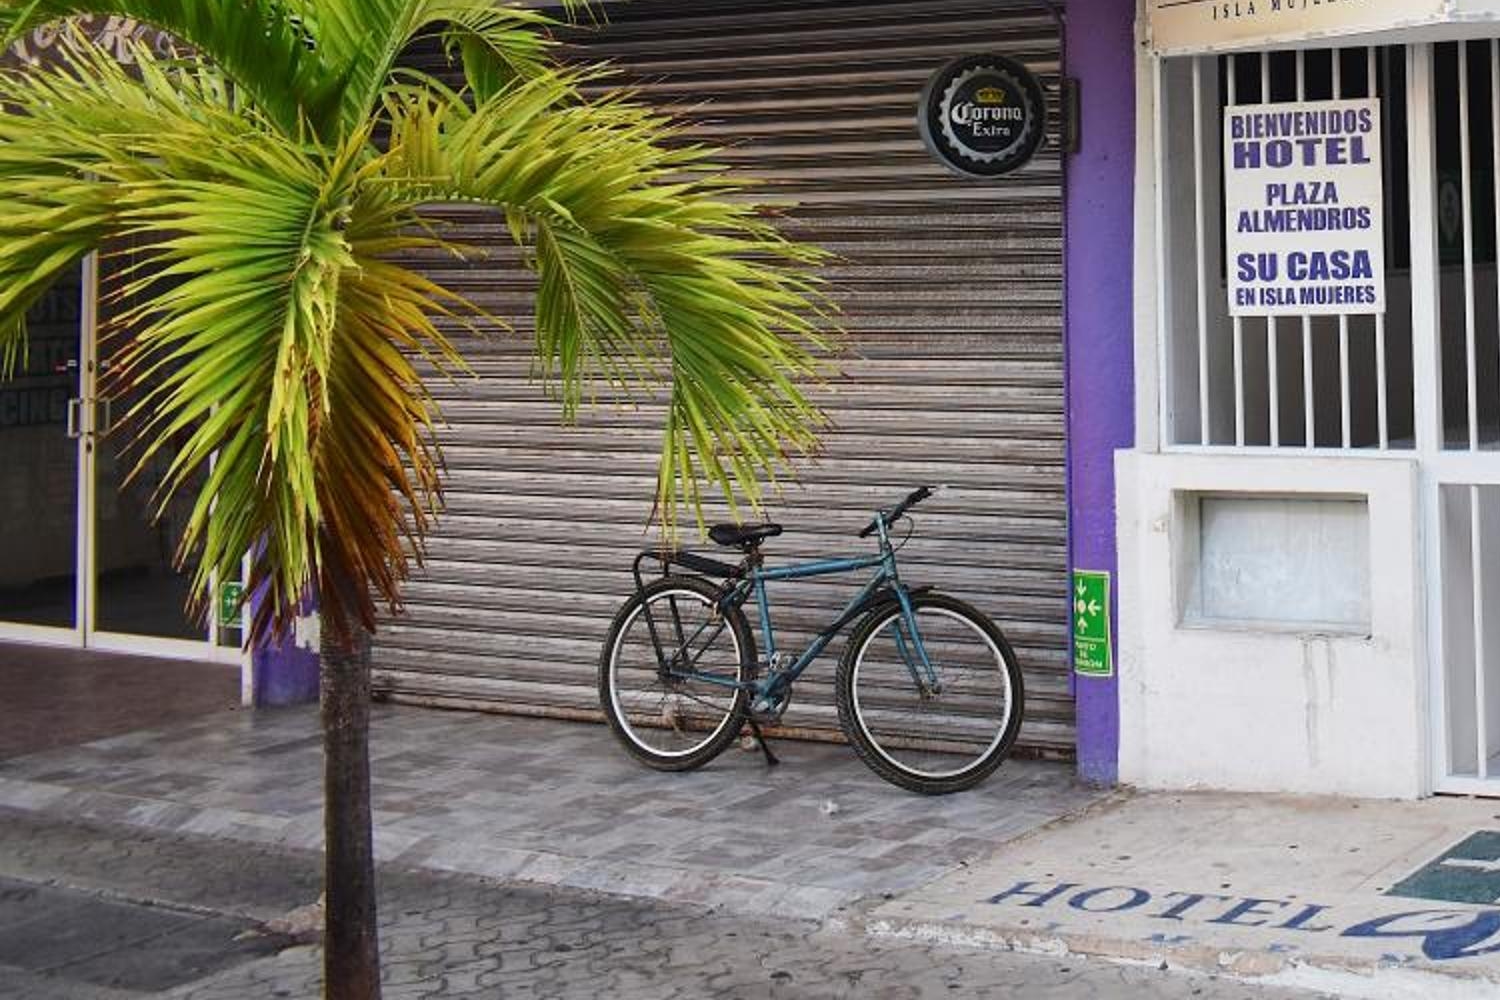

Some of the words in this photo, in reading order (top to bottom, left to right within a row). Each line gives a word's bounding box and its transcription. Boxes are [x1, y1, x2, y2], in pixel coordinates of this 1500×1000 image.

[1212, 1, 1256, 21] ISLA
[951, 101, 1023, 126] Corona
[1231, 108, 1373, 139] BIENVENIDOS
[972, 121, 1011, 137] Extra
[1233, 136, 1371, 169] HOTEL
[1266, 181, 1339, 206] PLAZA
[1237, 206, 1372, 233] ALMENDROS
[1237, 252, 1279, 282] SU
[1287, 250, 1374, 281] CASA
[1235, 287, 1256, 306] EN
[1260, 286, 1297, 306] ISLA
[1300, 285, 1376, 305] MUJERES
[975, 881, 1336, 932] HOTEL
